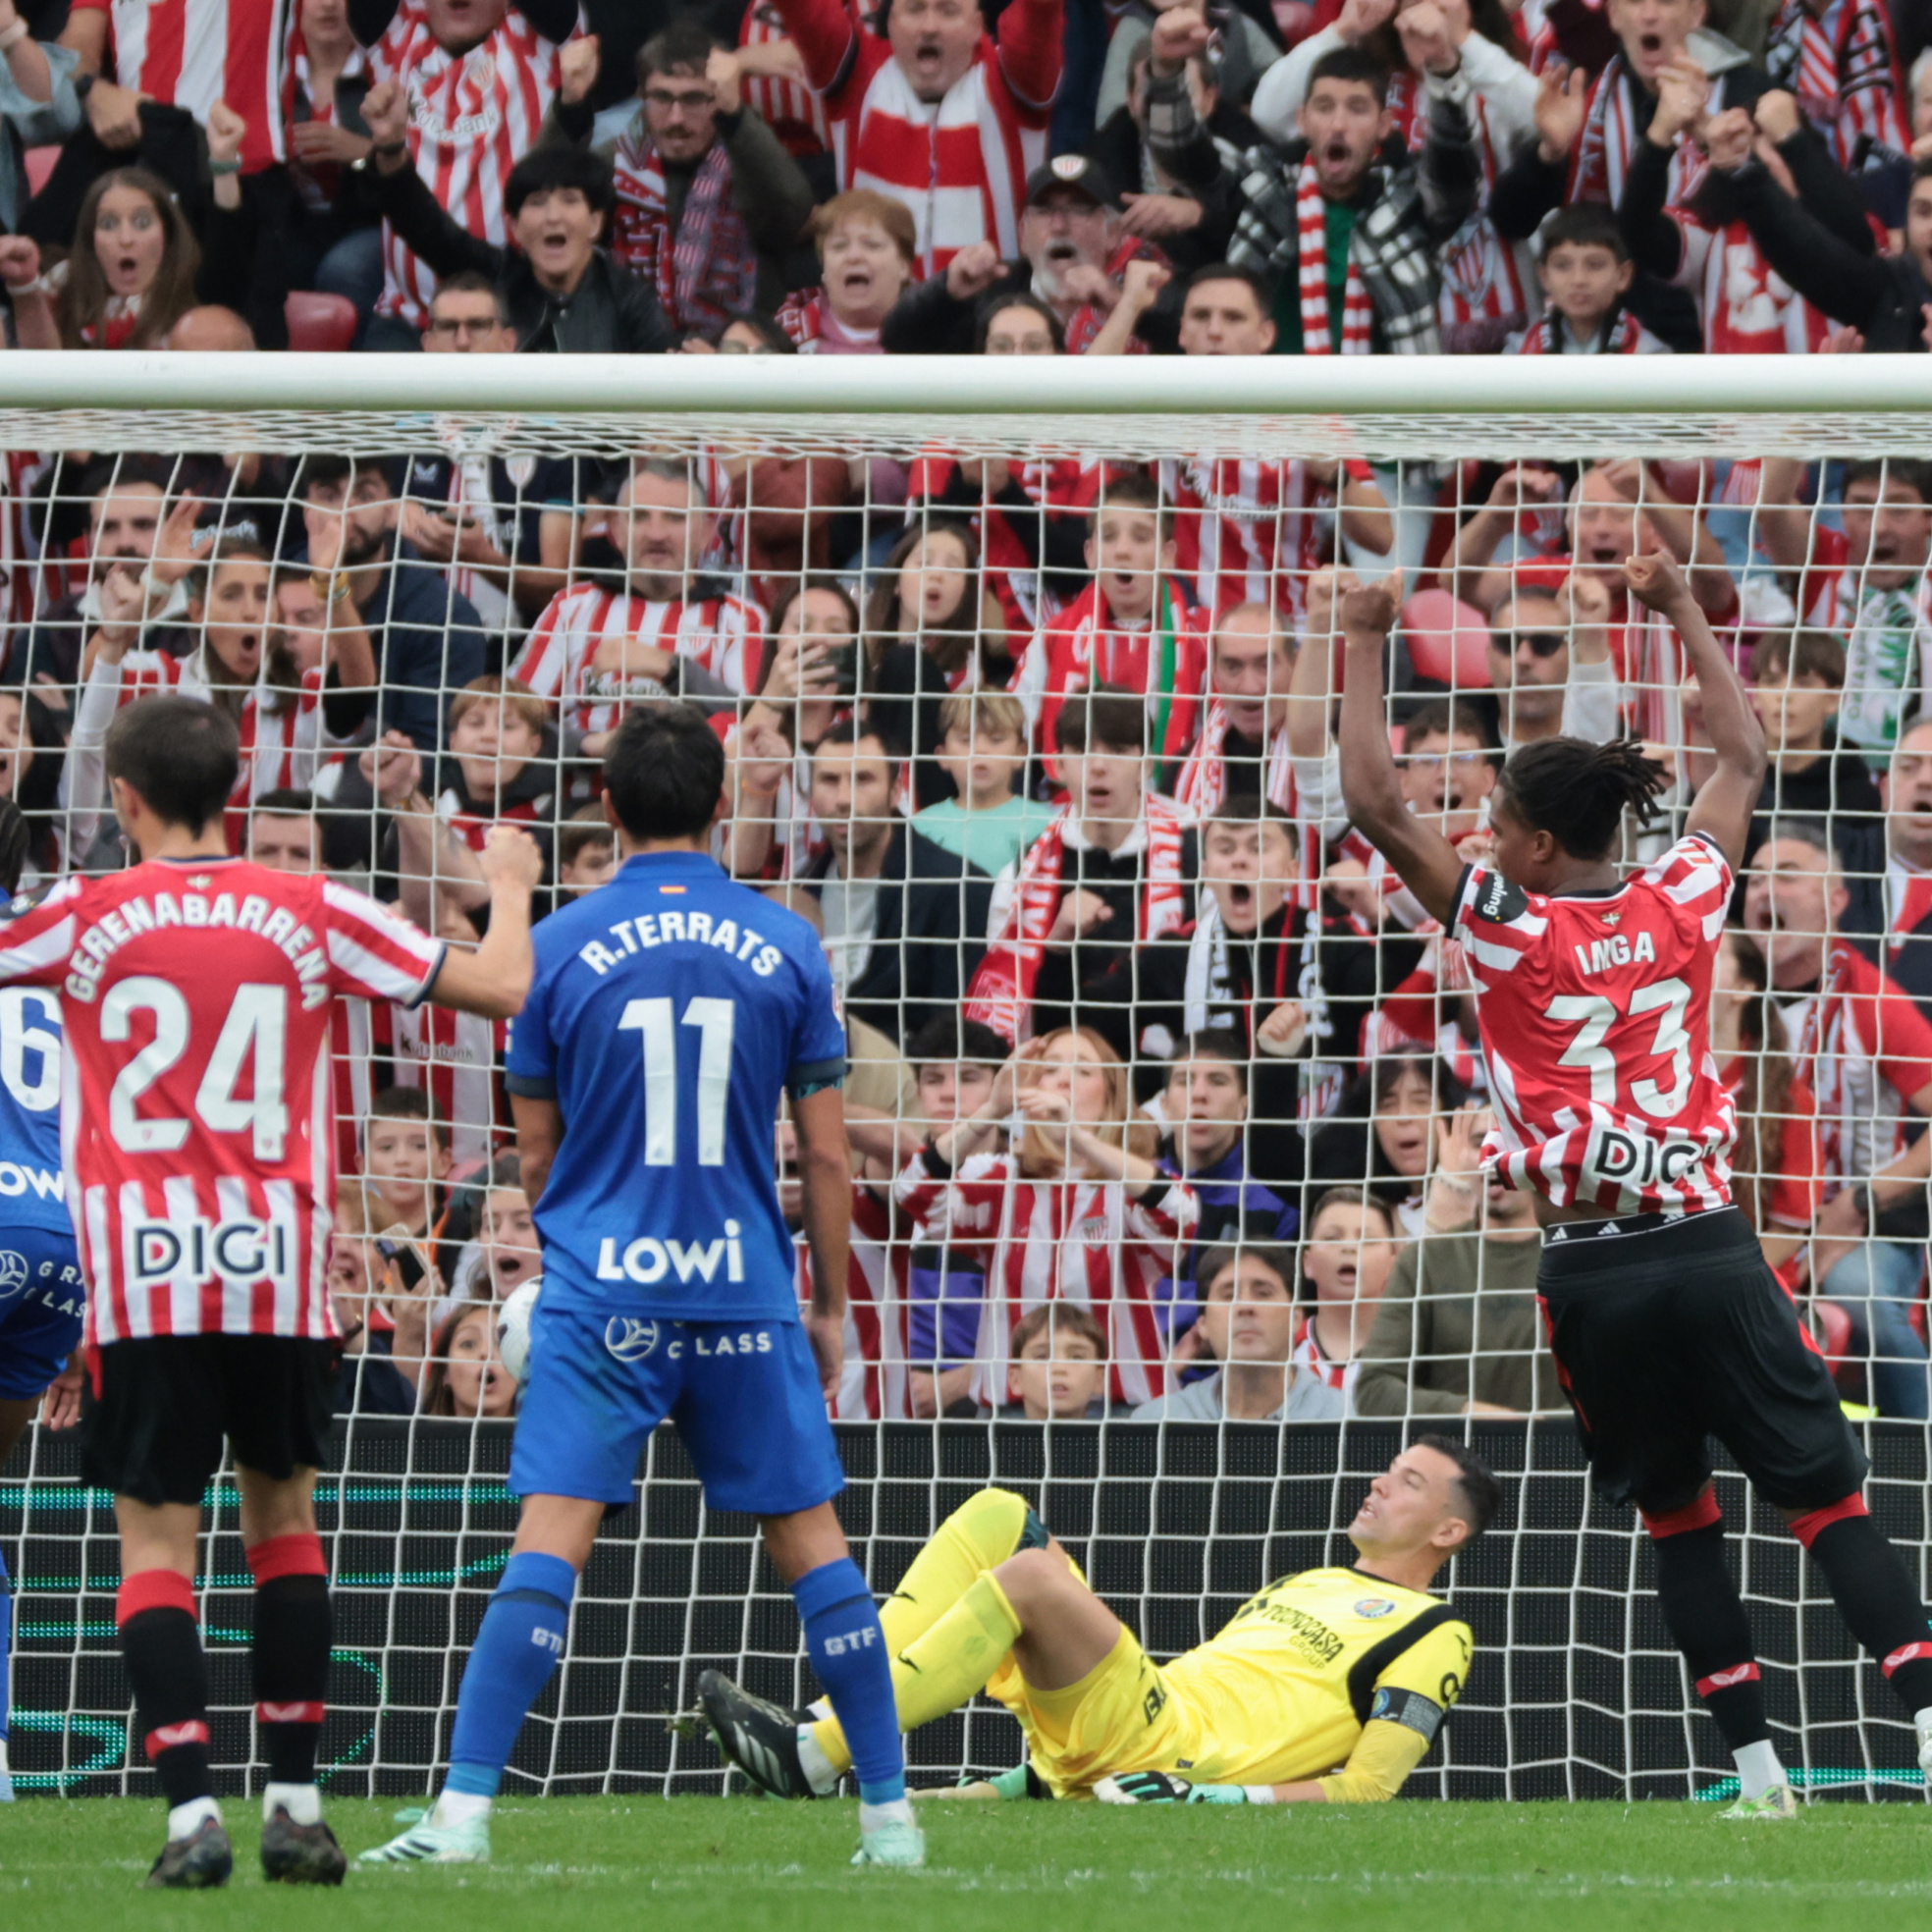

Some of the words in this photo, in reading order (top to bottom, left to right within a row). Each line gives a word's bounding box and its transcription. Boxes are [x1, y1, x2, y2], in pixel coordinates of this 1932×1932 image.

[65, 891, 329, 1012] GERENABARRENA
[578, 911, 783, 977] R.TERRATS
[99, 975, 289, 1161] 24
[1543, 977, 1692, 1118] 33
[617, 996, 734, 1166] 11
[39, 1261, 83, 1285] GR
[134, 1222, 286, 1278] DIGI
[824, 1626, 878, 1656] GTF
[1289, 1635, 1325, 1670] GROUP
